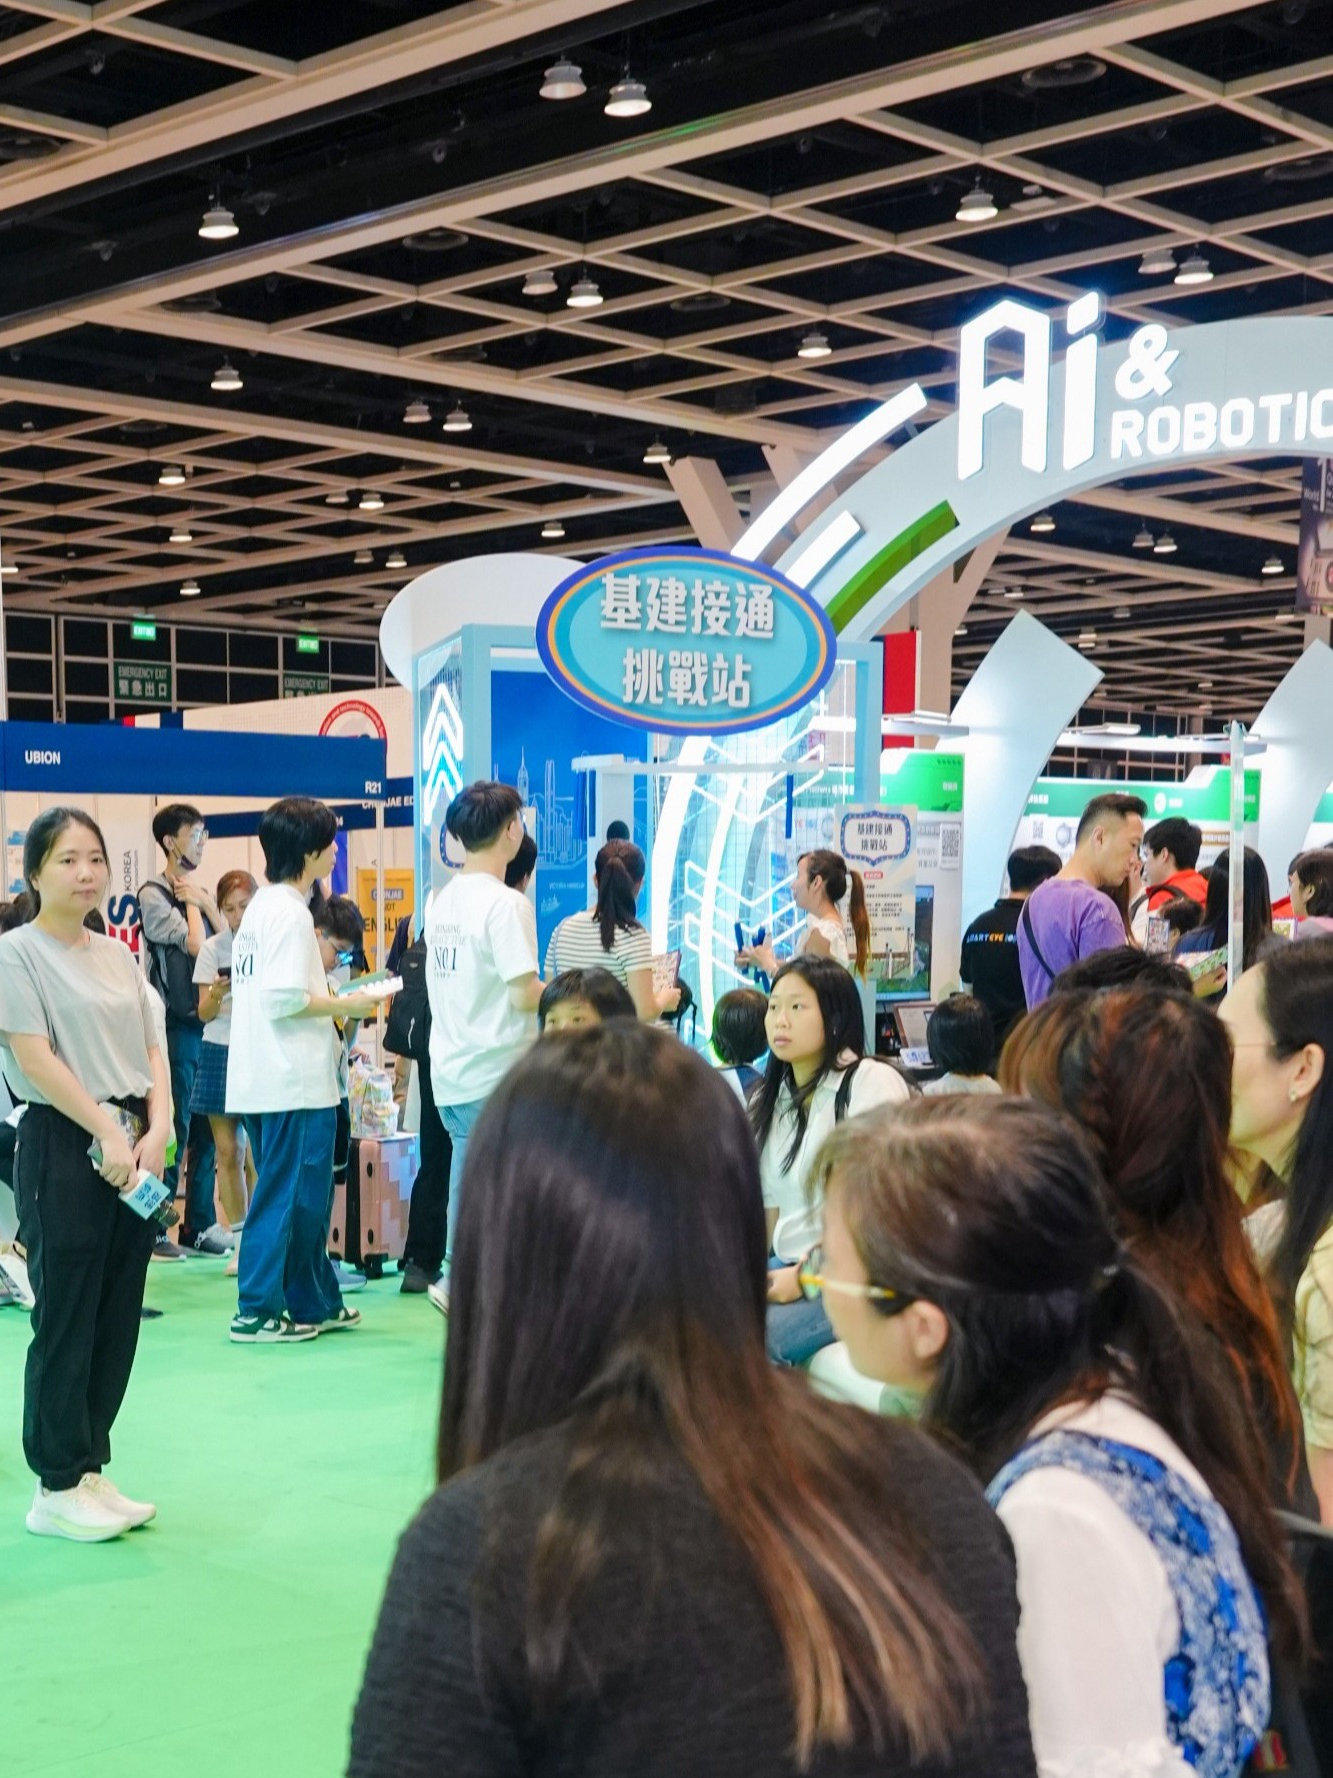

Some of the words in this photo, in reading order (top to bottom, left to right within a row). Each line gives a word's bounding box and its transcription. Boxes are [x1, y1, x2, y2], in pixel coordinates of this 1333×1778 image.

[956, 290, 1100, 480] Ai
[1115, 323, 1180, 400] &
[1110, 388, 1333, 460] ROBOTIC
[600, 572, 774, 639] 基建接通
[118, 666, 153, 679] EMERGENCY
[155, 668, 167, 680] EXIT
[622, 647, 752, 709] 挑戰站
[25, 750, 61, 765] UBION
[365, 781, 381, 794] R21
[123, 850, 132, 892] KOREA
